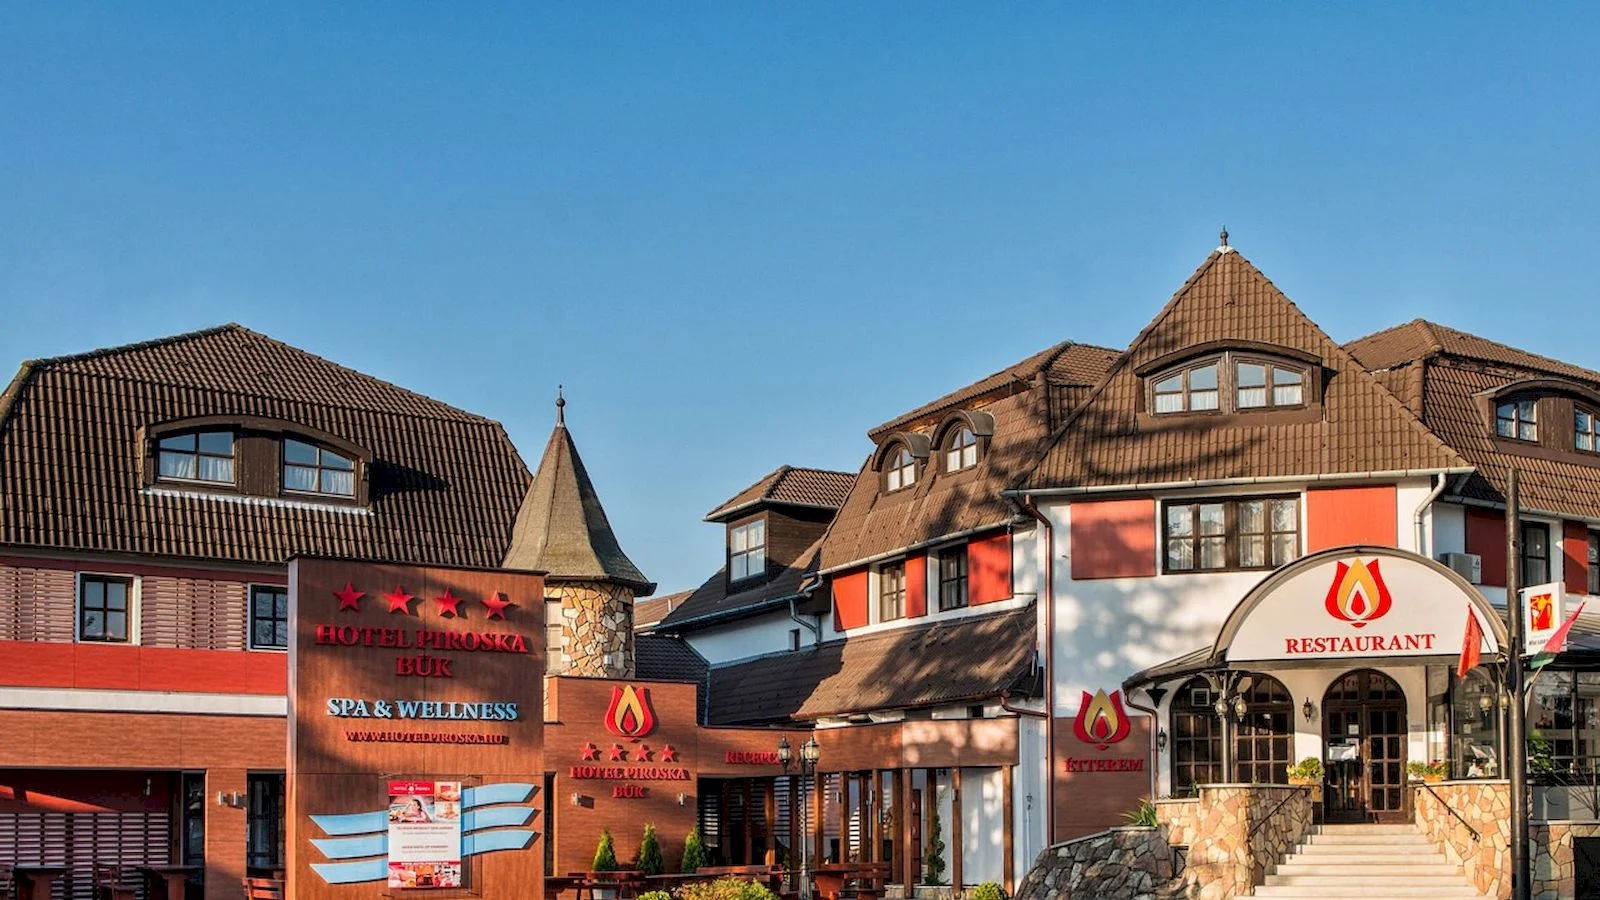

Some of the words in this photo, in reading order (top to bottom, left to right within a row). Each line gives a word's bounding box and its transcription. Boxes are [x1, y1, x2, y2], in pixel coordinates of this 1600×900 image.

[315, 624, 411, 648] HOTEL
[416, 630, 528, 653] PIROSKA
[1285, 634, 1435, 654] RESTAURANT
[396, 655, 452, 677] BÜK
[327, 698, 370, 716] SPA
[374, 701, 392, 719] &
[396, 700, 518, 720] WELLNESS
[345, 731, 507, 744] WWW.HOTELPIROSKA.HU
[569, 766, 621, 780] HOTEL
[624, 767, 686, 781] PIROSKA
[1064, 757, 1144, 773] ÉTTEREM
[613, 784, 645, 799] BÜK
